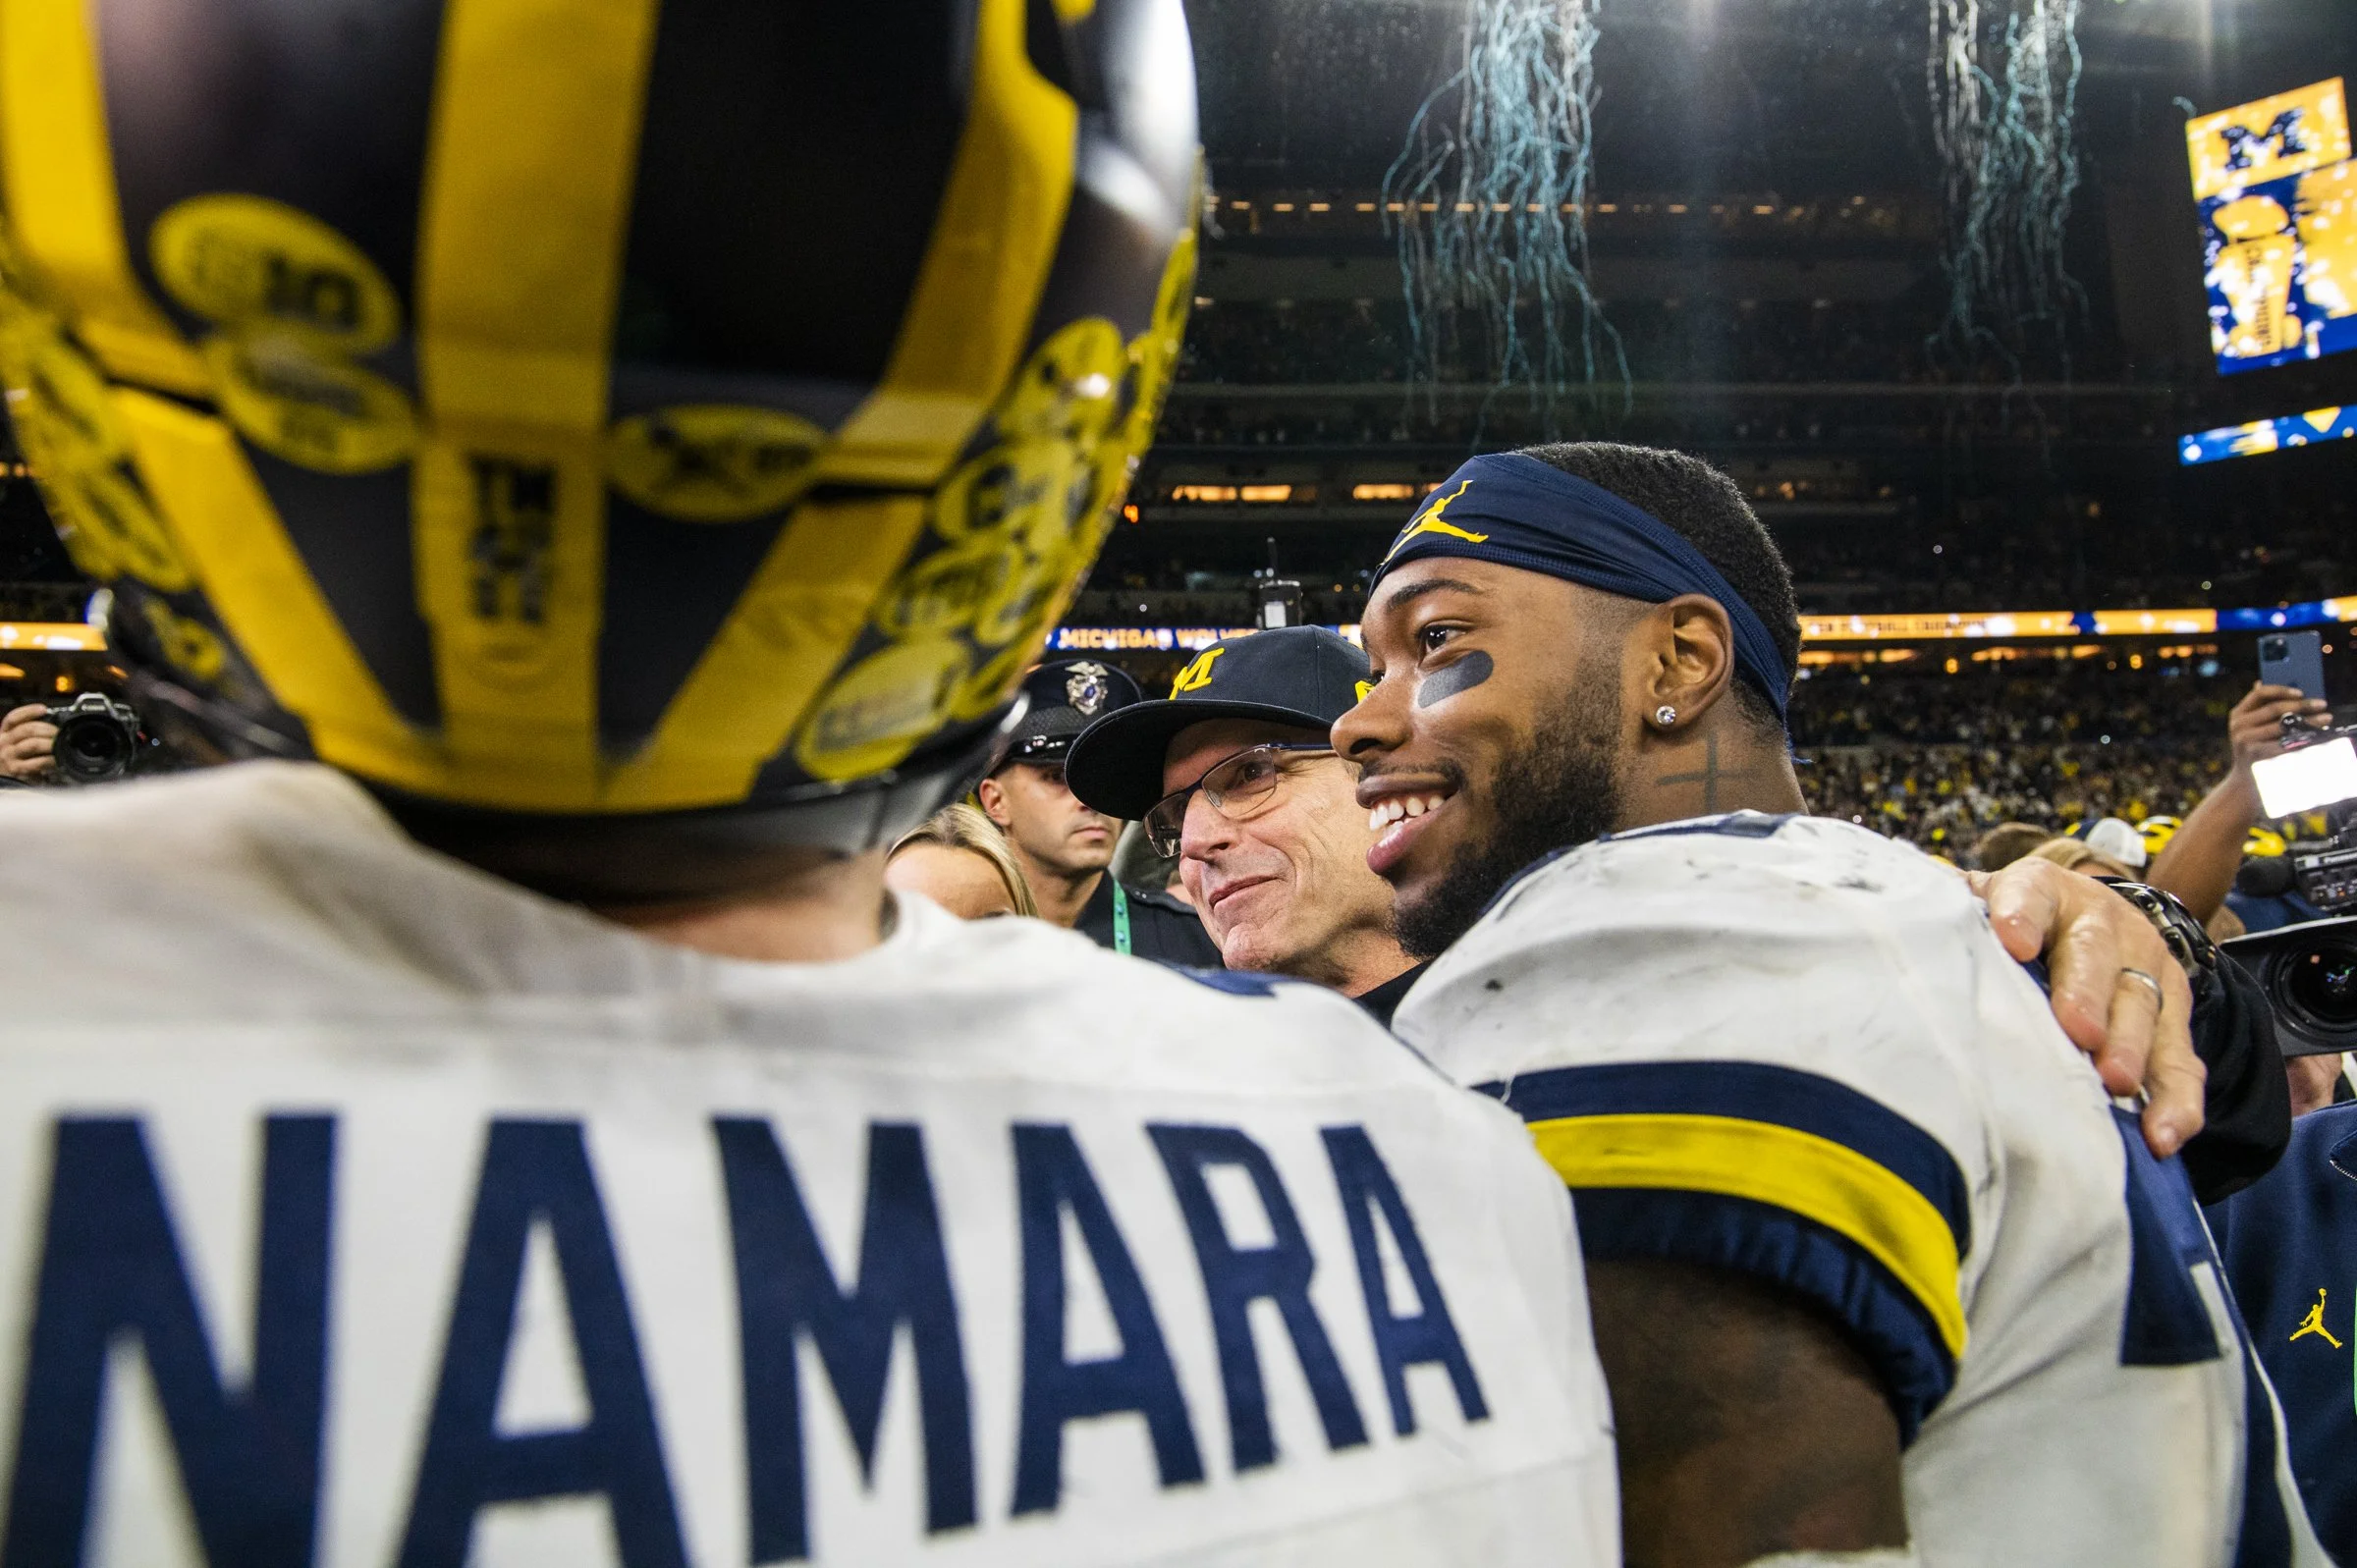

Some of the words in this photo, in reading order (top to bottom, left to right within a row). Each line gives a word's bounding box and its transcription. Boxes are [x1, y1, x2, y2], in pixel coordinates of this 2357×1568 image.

[2220, 107, 2306, 171] M
[1176, 628, 1258, 650] WOLVE
[2, 1110, 1491, 1568] NAMARA
